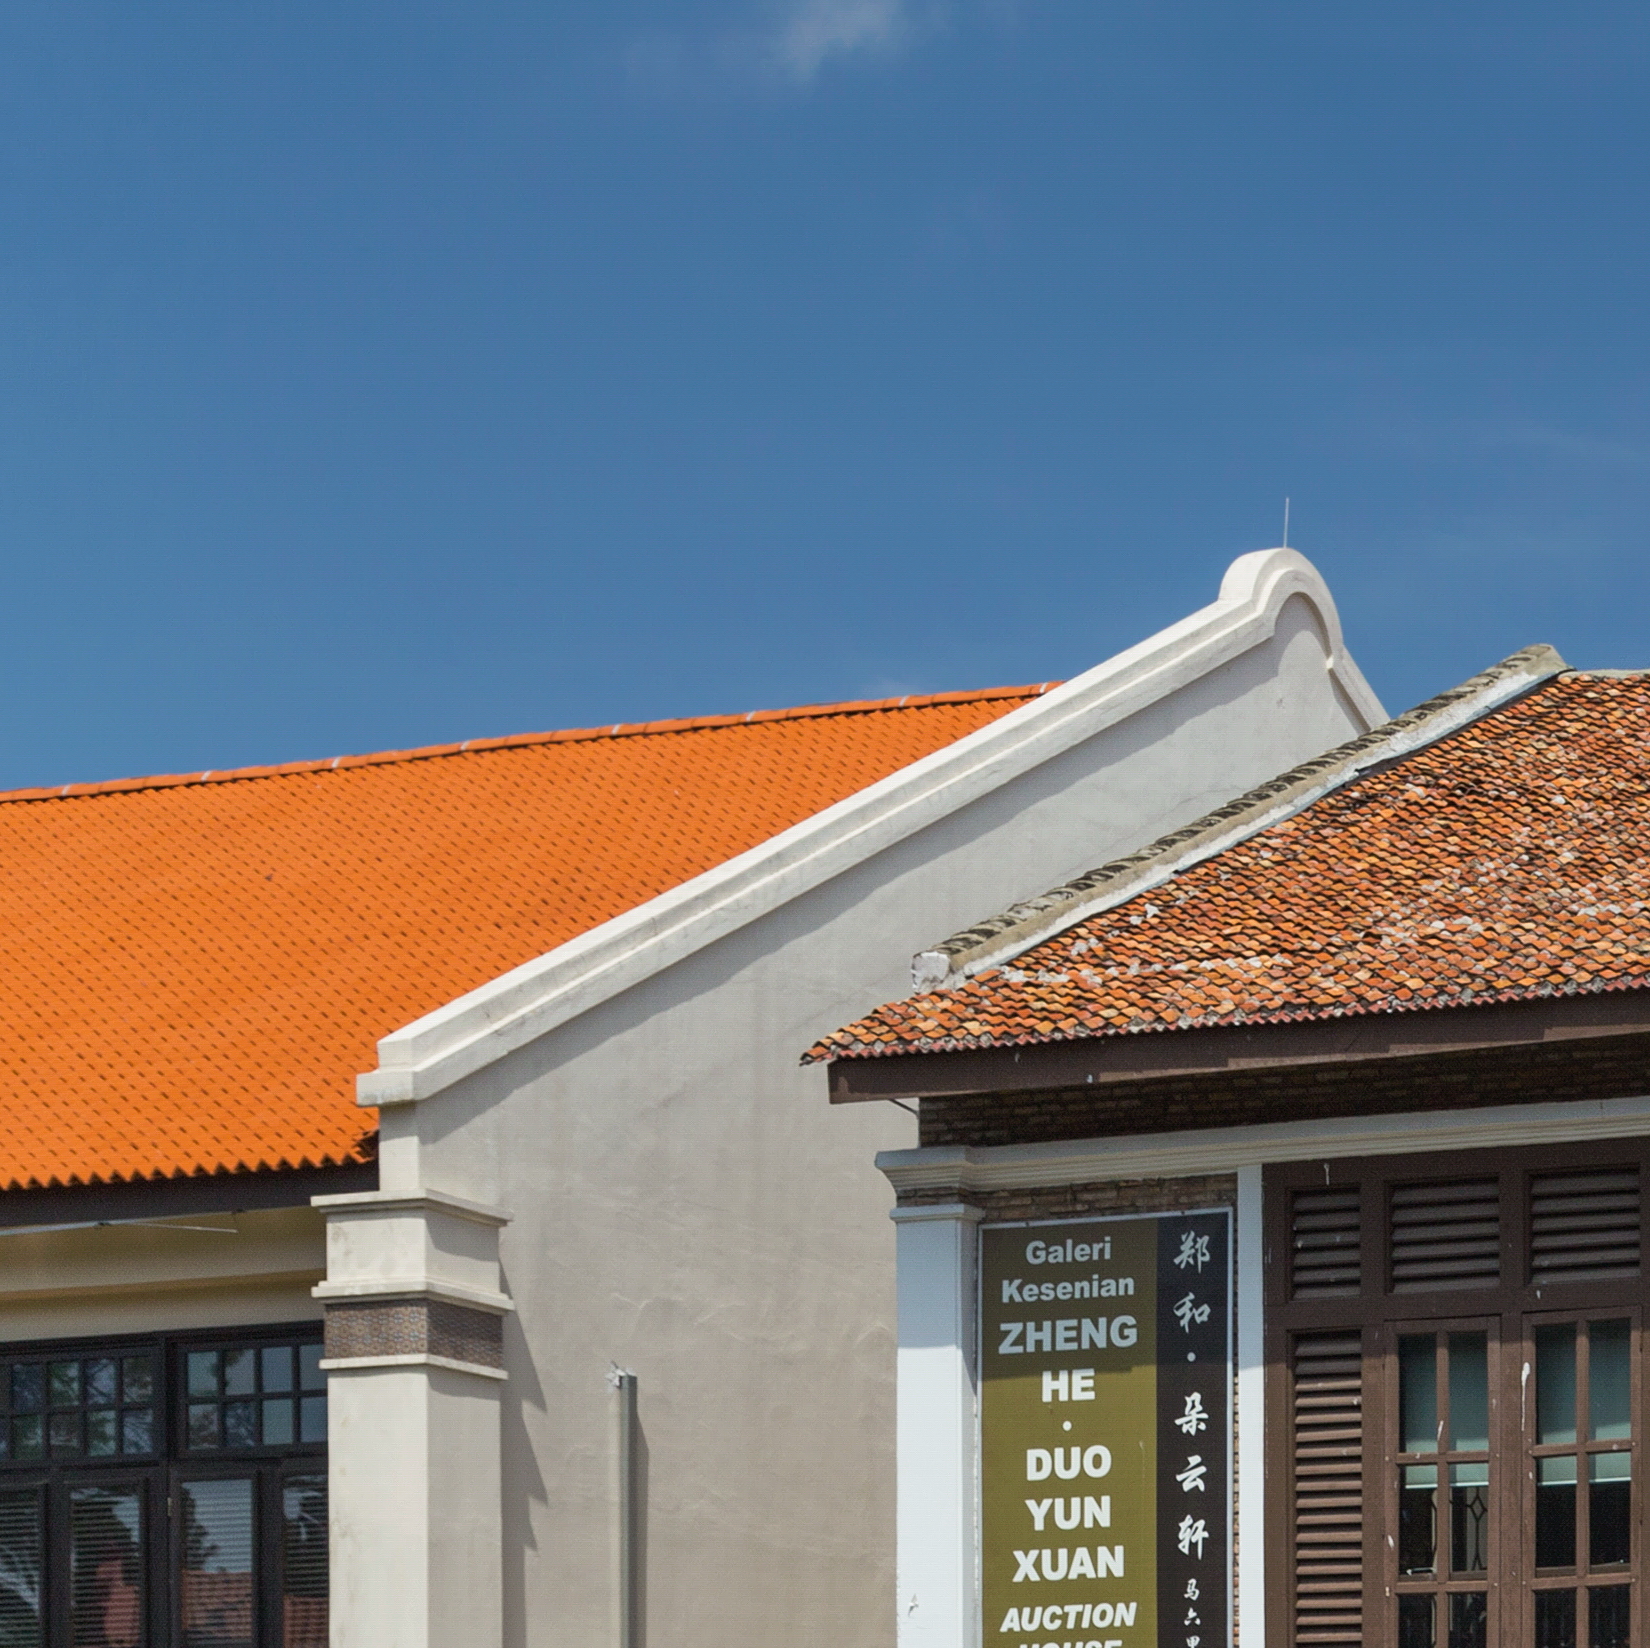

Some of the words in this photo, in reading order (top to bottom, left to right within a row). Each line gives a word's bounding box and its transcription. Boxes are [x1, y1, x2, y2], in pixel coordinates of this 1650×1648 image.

[1026, 1237, 1111, 1265] Galeri
[1002, 1274, 1134, 1303] Kesenian
[999, 1315, 1137, 1354] ZHENG
[1042, 1369, 1095, 1402] HE
[1027, 1445, 1111, 1481] DUO
[1025, 1496, 1111, 1531] YUN
[1012, 1545, 1124, 1583] XUAN
[1000, 1601, 1137, 1632] AUCTION
